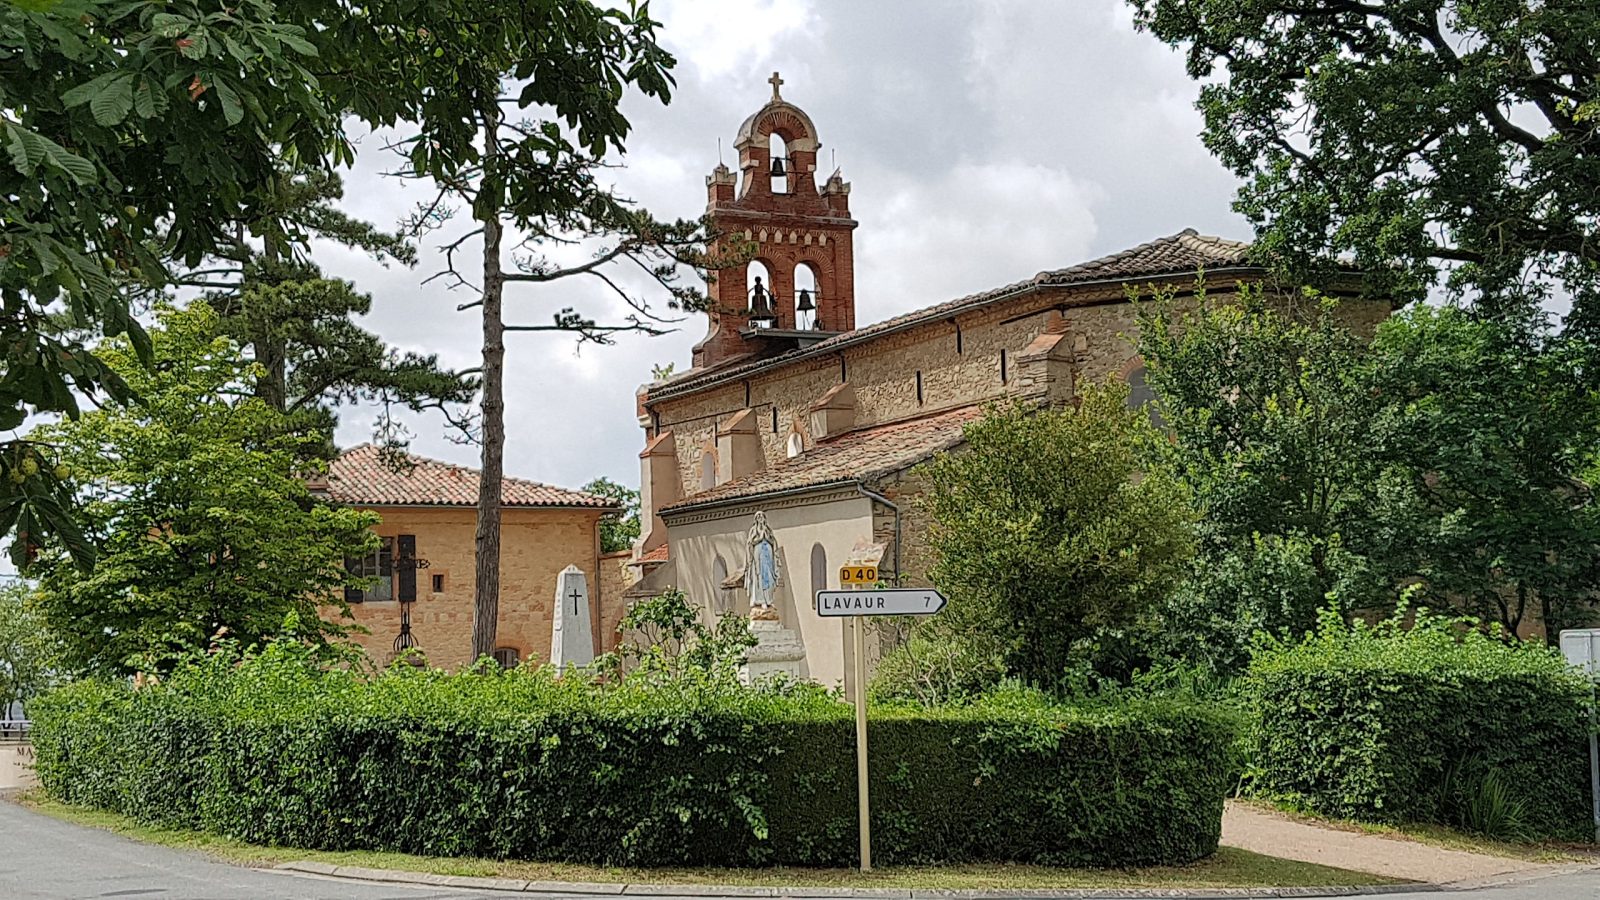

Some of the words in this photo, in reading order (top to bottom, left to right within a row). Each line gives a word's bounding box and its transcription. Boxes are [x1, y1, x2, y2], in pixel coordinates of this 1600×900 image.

[842, 569, 850, 581] D
[855, 569, 875, 580] 40
[824, 597, 885, 609] LAVAUR
[923, 596, 931, 607] 7
